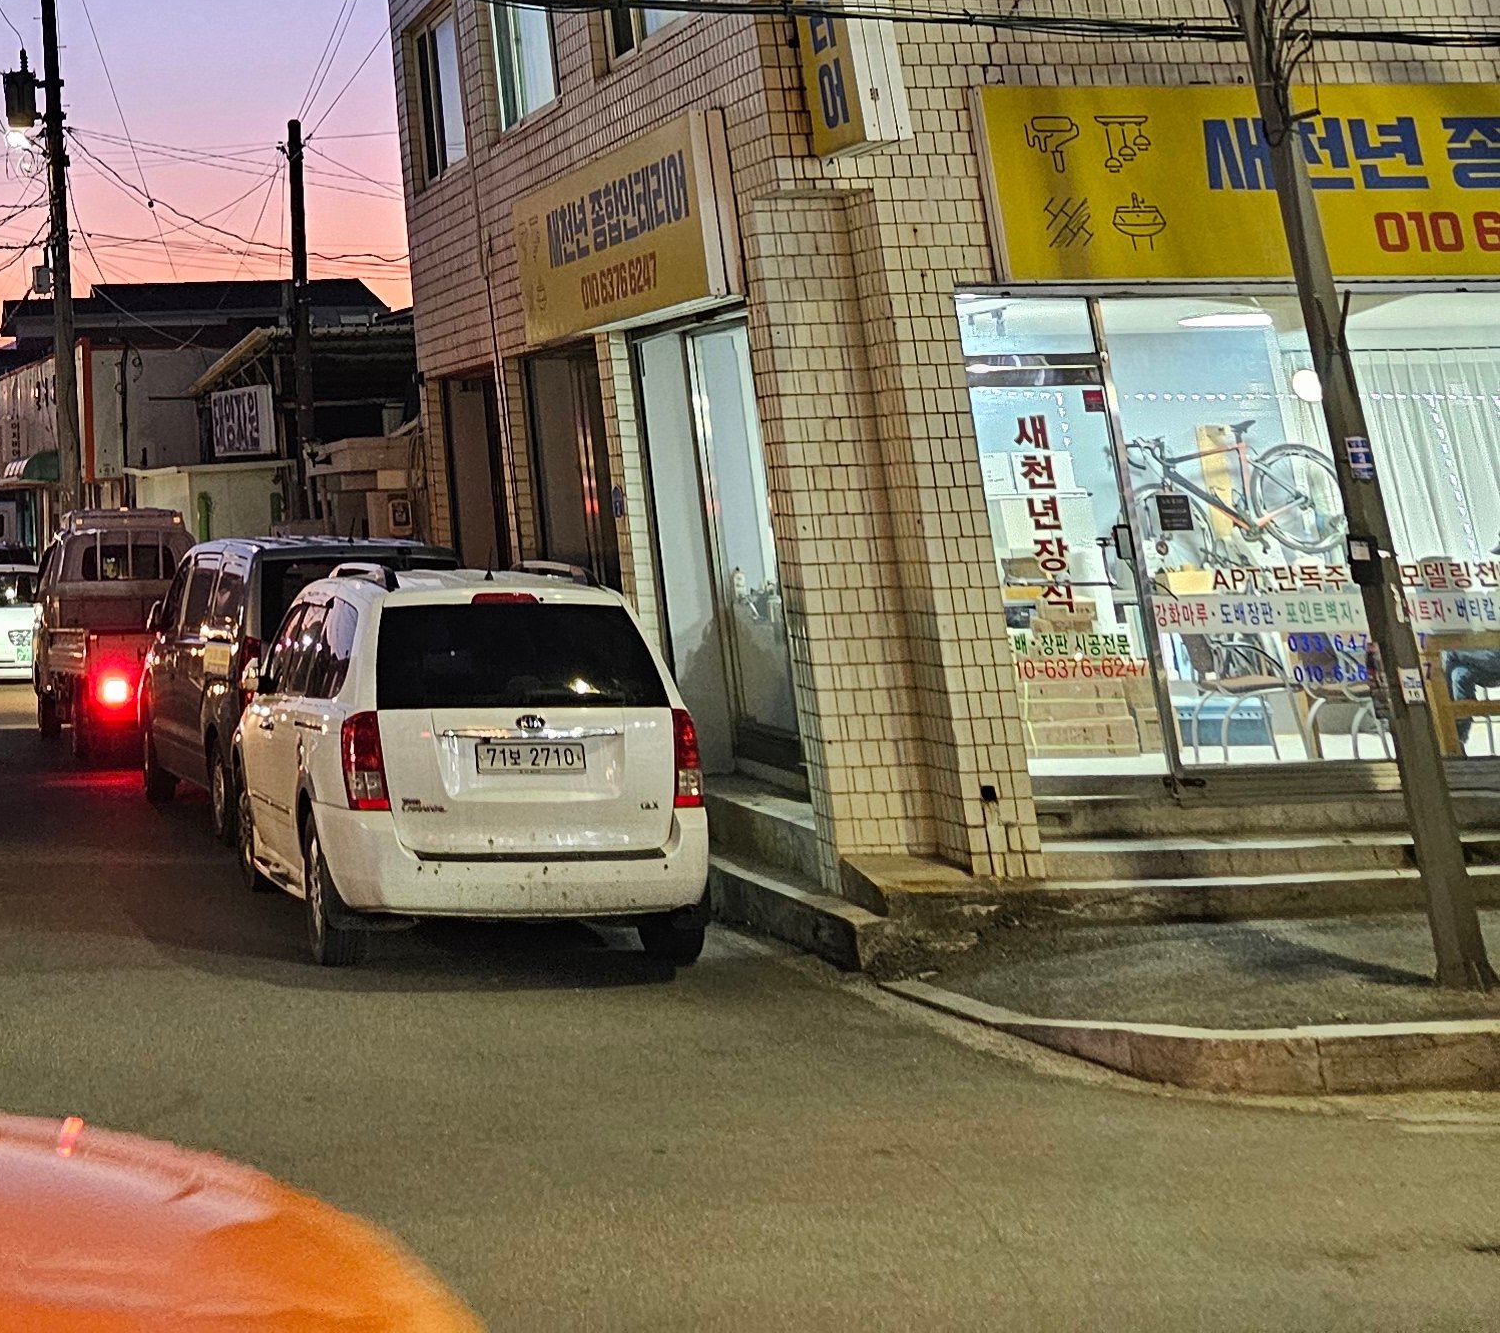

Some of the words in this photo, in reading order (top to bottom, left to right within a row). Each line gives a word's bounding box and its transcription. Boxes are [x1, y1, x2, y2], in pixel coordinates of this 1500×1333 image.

[1203, 116, 1430, 190] 새천년
[545, 195, 590, 269] 새천년
[588, 149, 690, 253] 종합인테리어
[1374, 210, 1465, 253] 010
[581, 269, 600, 311] 010
[599, 261, 628, 306] 6376
[628, 251, 657, 297] 6247
[1014, 414, 1075, 614] 새천년장식
[1075, 632, 1131, 656] 시공전문
[486, 747, 521, 766] 71보
[530, 747, 575, 766] 2710
